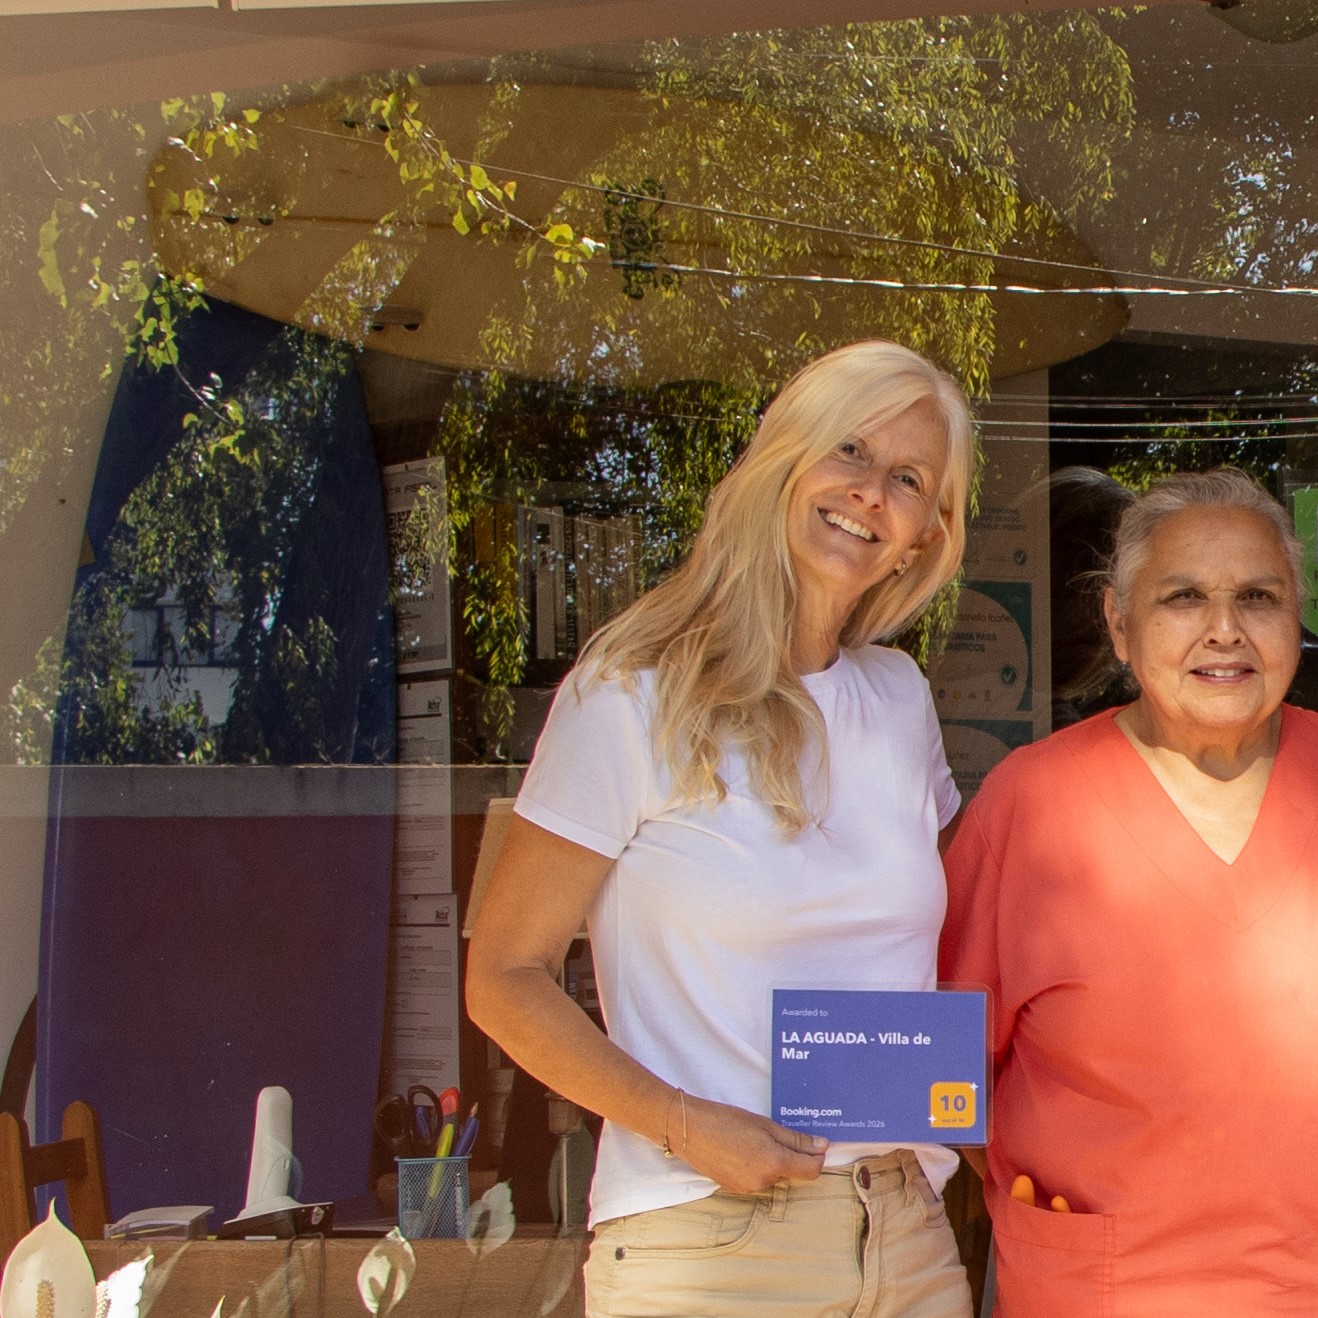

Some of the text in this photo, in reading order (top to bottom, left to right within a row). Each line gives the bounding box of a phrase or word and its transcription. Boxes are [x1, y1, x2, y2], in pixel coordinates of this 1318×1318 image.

[781, 1008, 829, 1017] Awarded to
[781, 1031, 801, 1044] LA
[802, 1031, 868, 1045] AGUADA
[878, 1033, 909, 1045] Villa
[912, 1033, 931, 1045] de
[781, 1047, 811, 1060] Mar
[940, 1094, 967, 1112] 10
[780, 1106, 842, 1118] Booking.com
[839, 1120, 866, 1128] Awards
